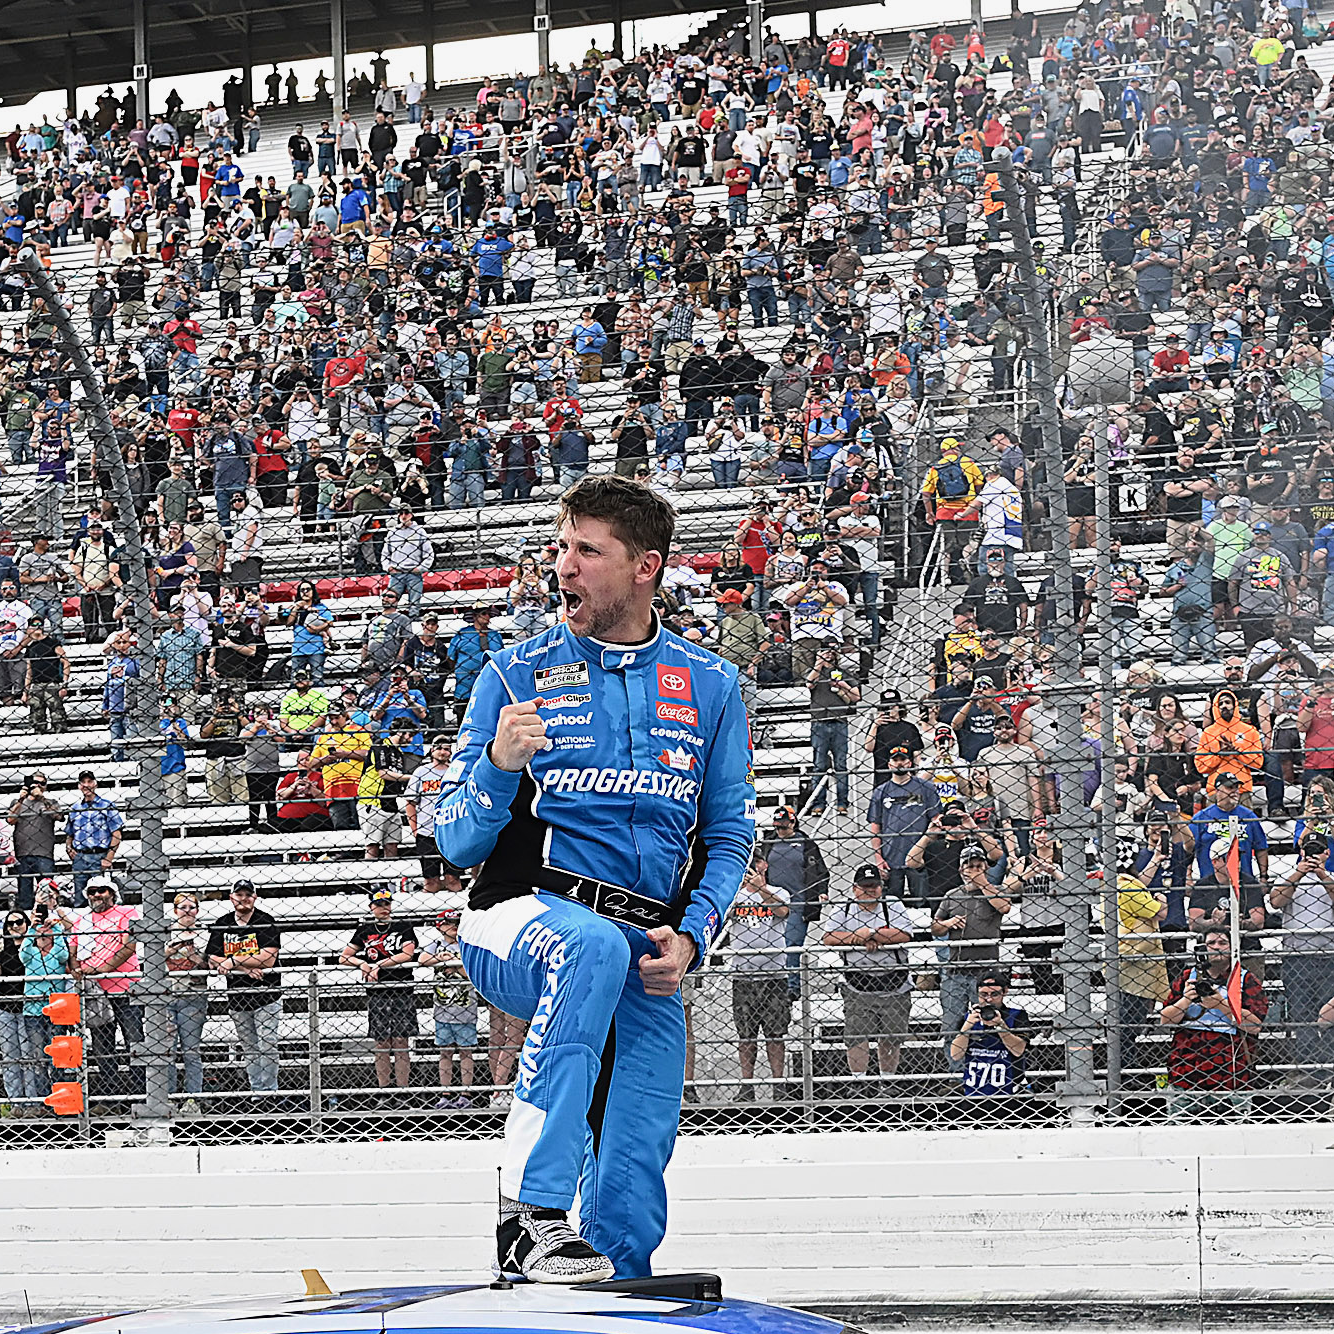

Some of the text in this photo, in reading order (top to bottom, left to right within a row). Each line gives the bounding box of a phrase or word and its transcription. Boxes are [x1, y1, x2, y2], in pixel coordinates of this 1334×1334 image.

[550, 664, 581, 677] NASCAR
[557, 673, 582, 684] SERIES
[555, 735, 596, 745] NATIONAL
[649, 727, 705, 748] GOODYEAR
[542, 767, 699, 803] PROGRESSIVE
[965, 1061, 1007, 1088] 570
